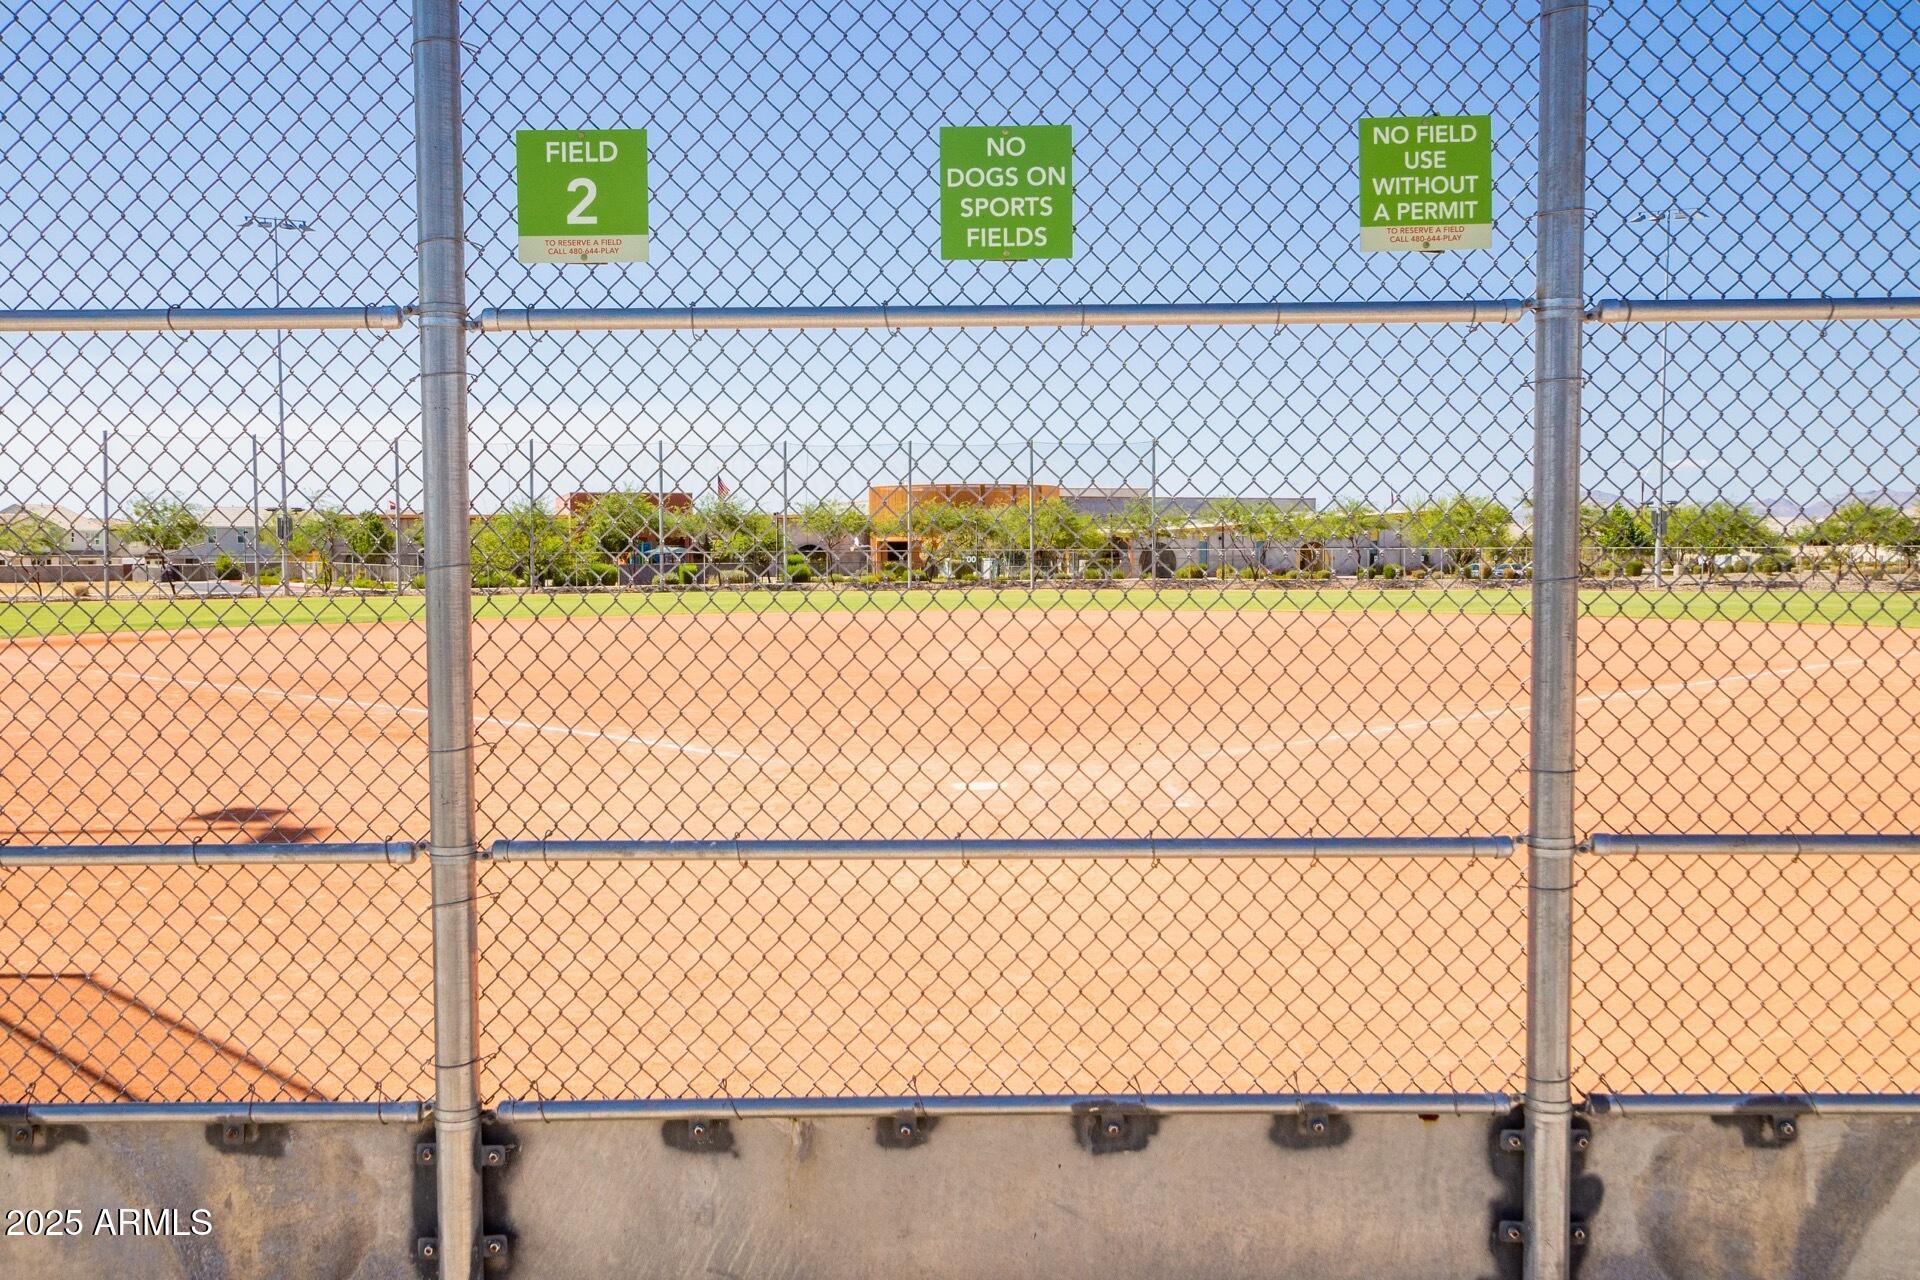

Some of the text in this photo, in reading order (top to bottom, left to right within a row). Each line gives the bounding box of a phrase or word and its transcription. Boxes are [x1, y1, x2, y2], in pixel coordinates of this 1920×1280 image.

[1373, 124, 1477, 145] NO FIELD
[545, 141, 618, 163] FIELD
[987, 137, 1026, 157] NO
[1404, 150, 1446, 170] USE
[947, 166, 1066, 188] DOGS ON
[1372, 175, 1479, 196] WITHOUT
[566, 177, 598, 225] 2
[960, 196, 1053, 218] SPORTS
[1373, 201, 1479, 222] A PERMIT
[967, 226, 1048, 248] FIELDS
[1386, 227, 1398, 235] TO
[1400, 226, 1434, 234] RESERVE
[1443, 225, 1465, 233] FIELD
[1389, 234, 1462, 243] CALL 480-644-PLAY
[544, 239, 556, 247] TO
[558, 239, 591, 247] RESERVE
[601, 238, 622, 246] FIELD
[568, 247, 619, 255] 480-644-PLAY
